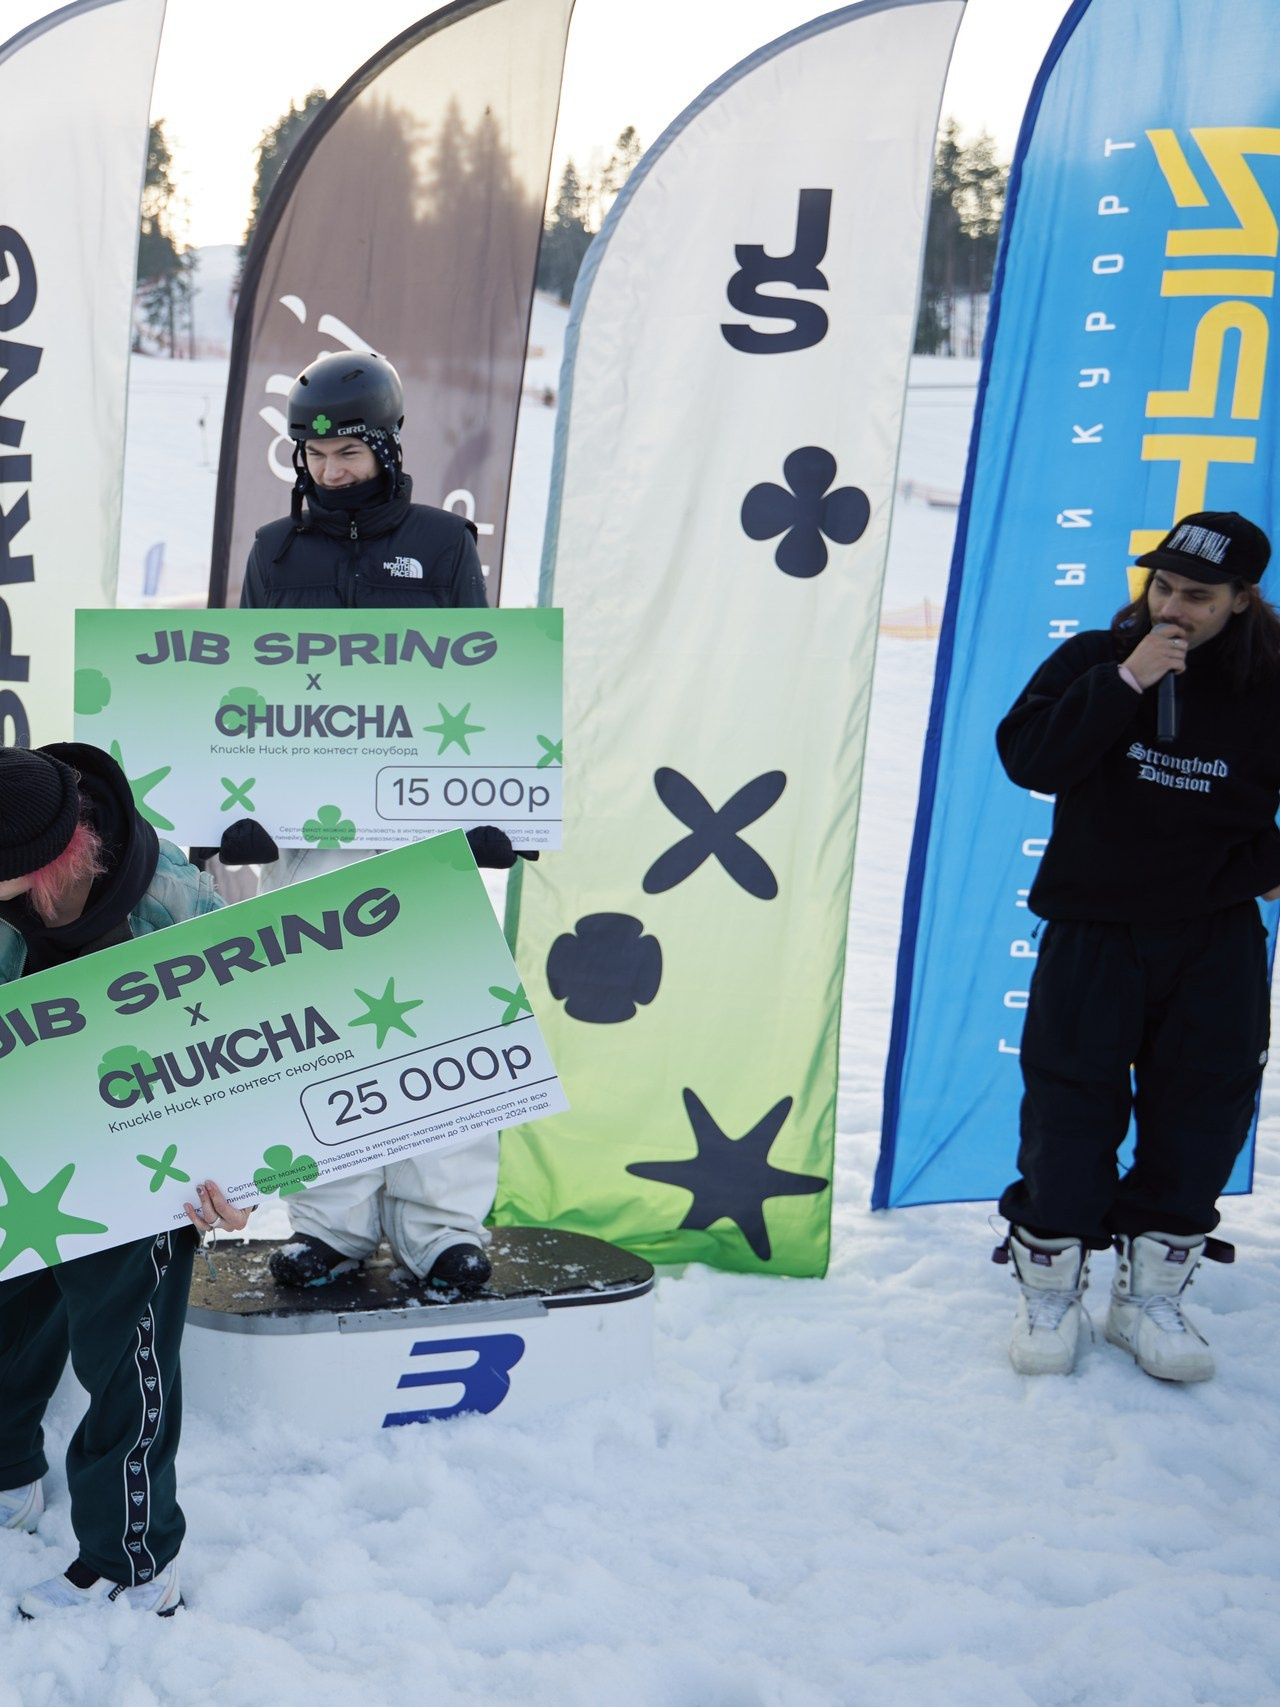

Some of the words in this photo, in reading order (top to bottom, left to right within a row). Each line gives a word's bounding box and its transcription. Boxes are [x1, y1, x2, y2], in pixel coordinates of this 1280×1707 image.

[1072, 138, 1136, 444] КУРОРТ
[337, 424, 366, 436] GIRO
[383, 562, 410, 571] NORTH
[390, 569, 410, 577] FACE
[395, 556, 411, 564] THE
[135, 629, 230, 666] JIB
[253, 629, 498, 669] SPRING
[214, 704, 413, 740] CHUKCHA
[210, 744, 255, 755] Knuckle
[259, 744, 288, 755] Huck
[291, 747, 310, 757] pro
[313, 747, 358, 756] контест
[361, 745, 418, 758] сноуборд
[1127, 742, 1228, 777] Stronghold
[392, 778, 430, 806] 15
[1138, 764, 1211, 792] Division
[106, 887, 401, 1016] SPRING
[98, 1004, 341, 1109] CHUKCHA
[108, 1108, 163, 1134] Knuckle
[164, 1096, 202, 1116] Huck
[203, 1089, 226, 1106] pro
[228, 1071, 282, 1096] контест
[285, 1048, 355, 1078] сноуборд
[325, 1079, 388, 1126] 25
[227, 1174, 278, 1194] Сертификат
[278, 1166, 307, 1182] можно
[307, 1148, 364, 1171] использовать
[372, 1119, 454, 1149] интернет-магазине
[455, 1100, 516, 1125] chukchas.com
[517, 1096, 528, 1105] на
[529, 1091, 548, 1102] всю
[260, 1179, 290, 1194] Обмен
[290, 1176, 301, 1185] на
[302, 1167, 331, 1183] деньги
[332, 1151, 387, 1173] невозможен.
[387, 1133, 446, 1157] Действителен
[447, 1128, 459, 1138] до
[460, 1124, 469, 1133] 31
[470, 1113, 504, 1130] августа
[505, 1107, 528, 1120] 2024
[529, 1101, 552, 1113] года.
[381, 1333, 526, 1428] 3
